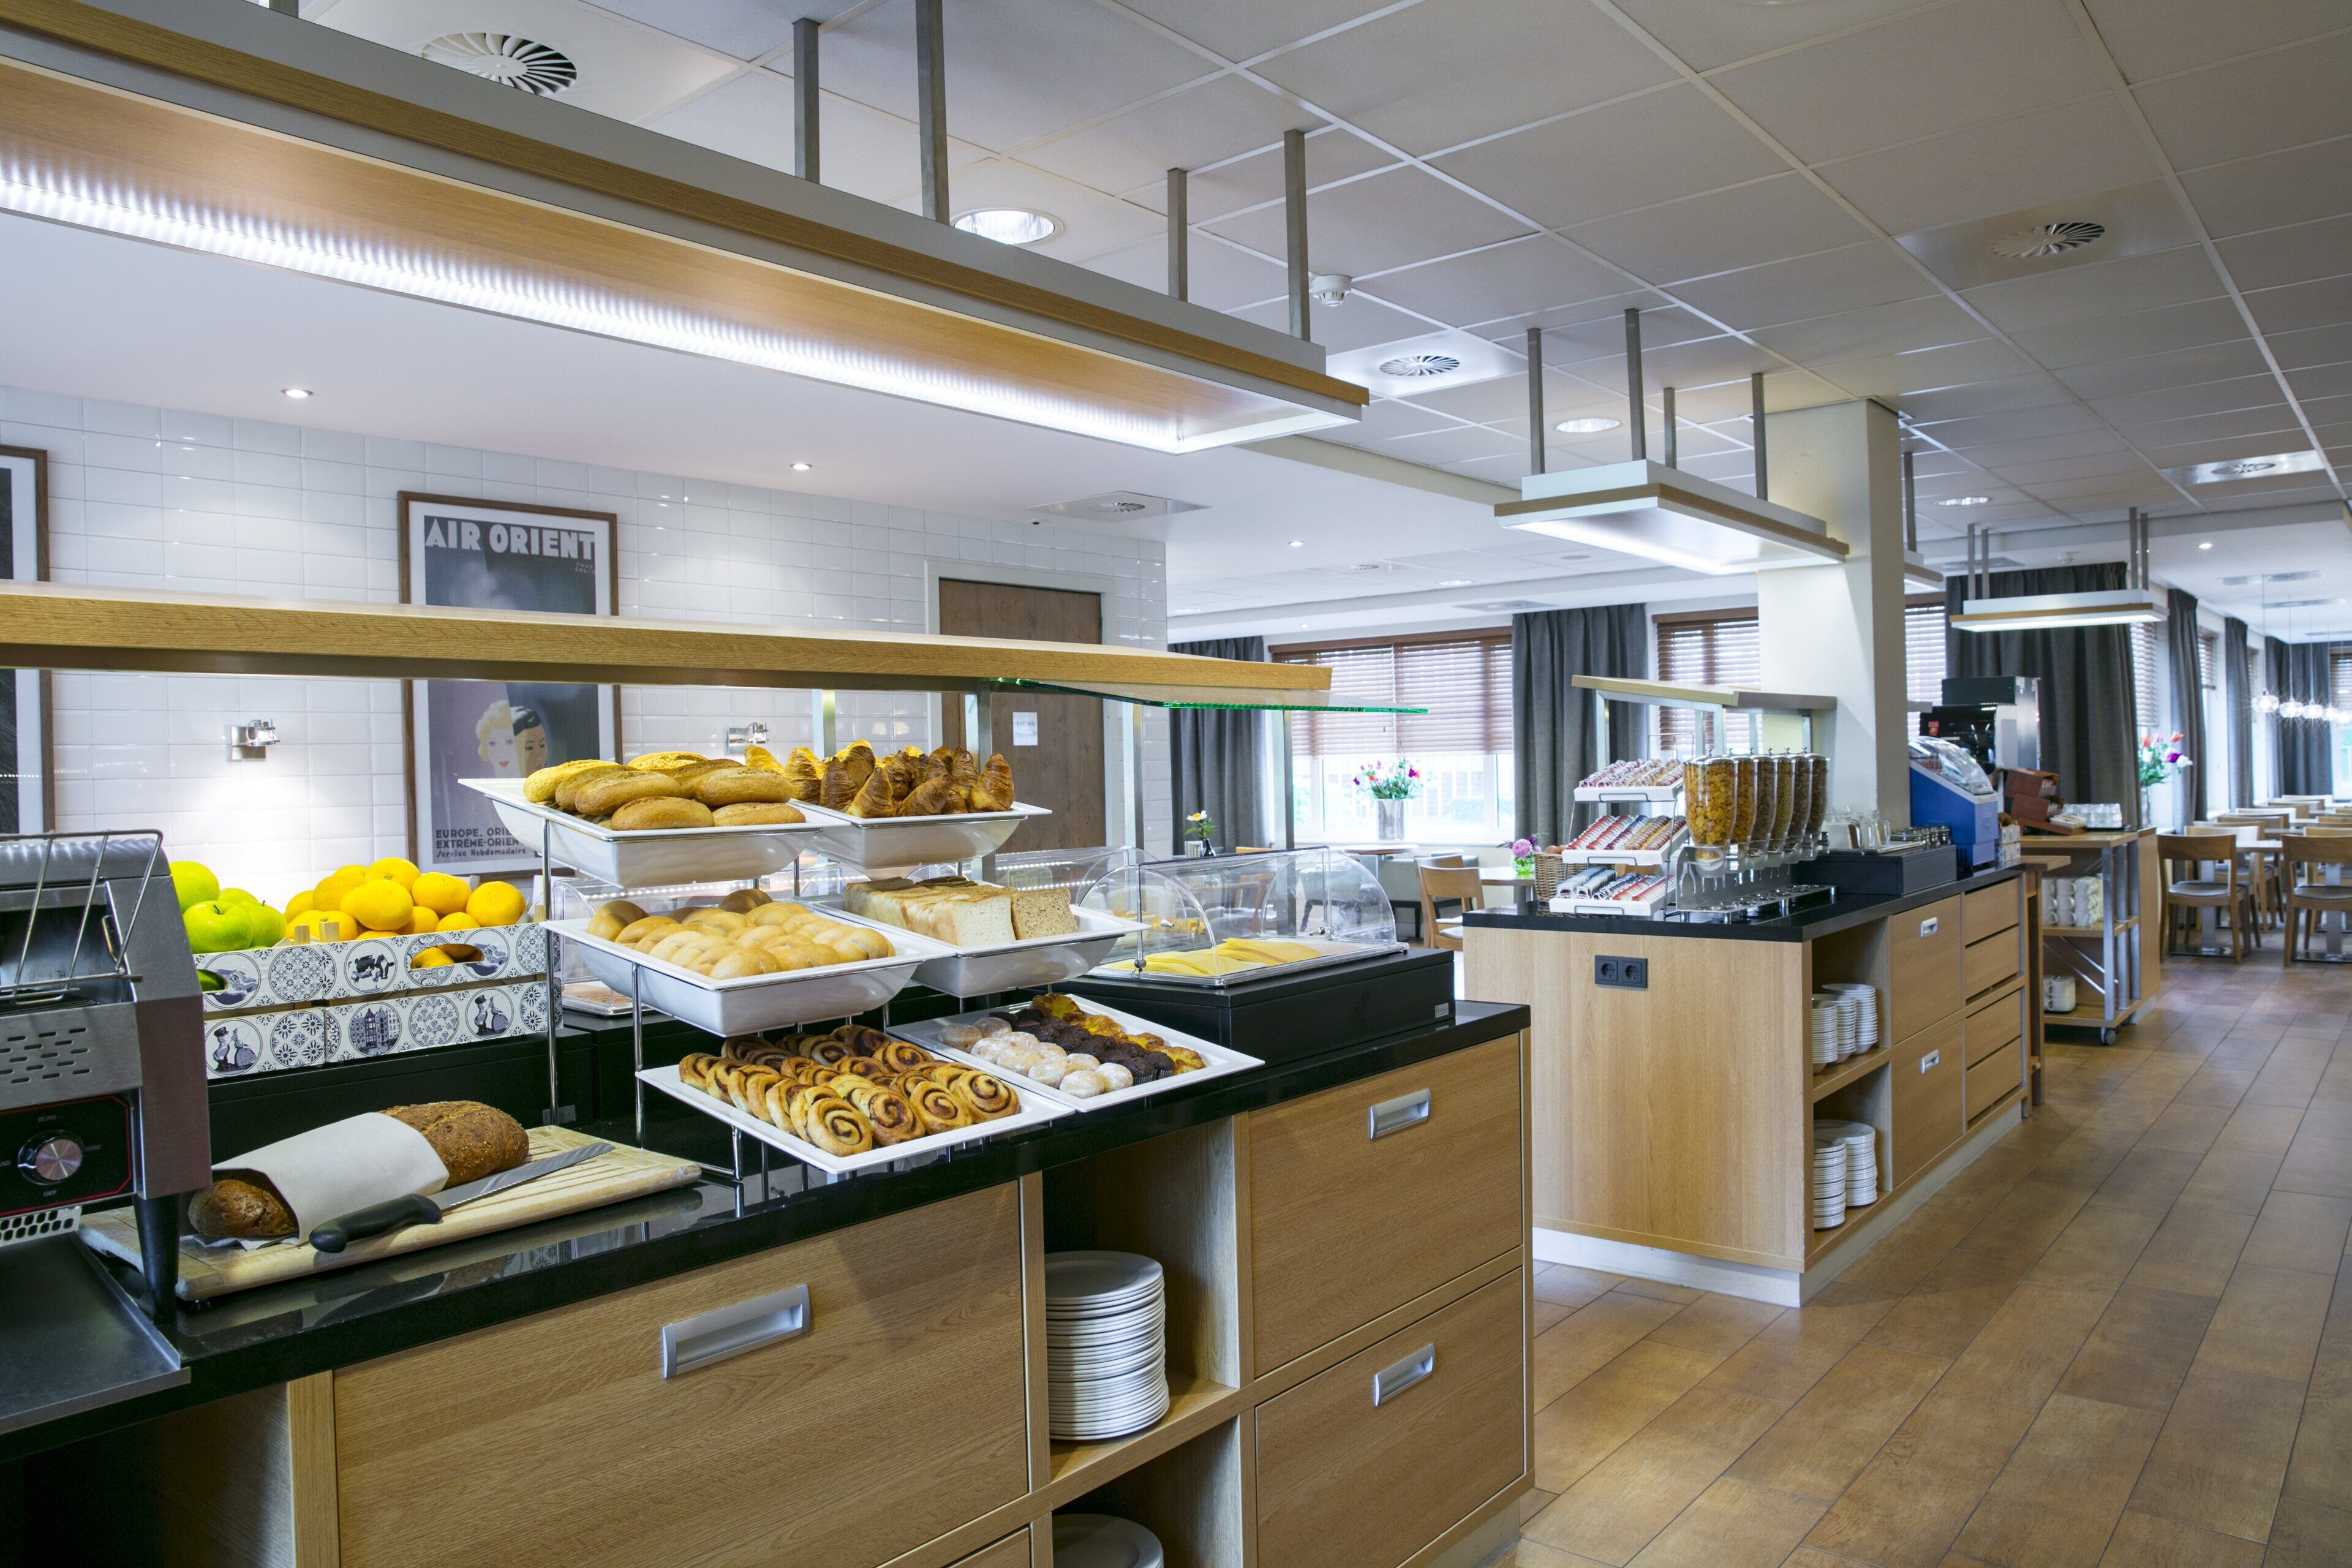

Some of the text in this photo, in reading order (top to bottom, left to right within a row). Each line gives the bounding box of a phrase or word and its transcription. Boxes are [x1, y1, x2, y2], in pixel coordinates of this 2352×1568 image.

[425, 518, 595, 560] AIR ORIENT
[436, 827, 511, 838] EUROPE. ORIE
[471, 848, 526, 856] Hebdomadaire
[38, 1114, 56, 1123] BUNS
